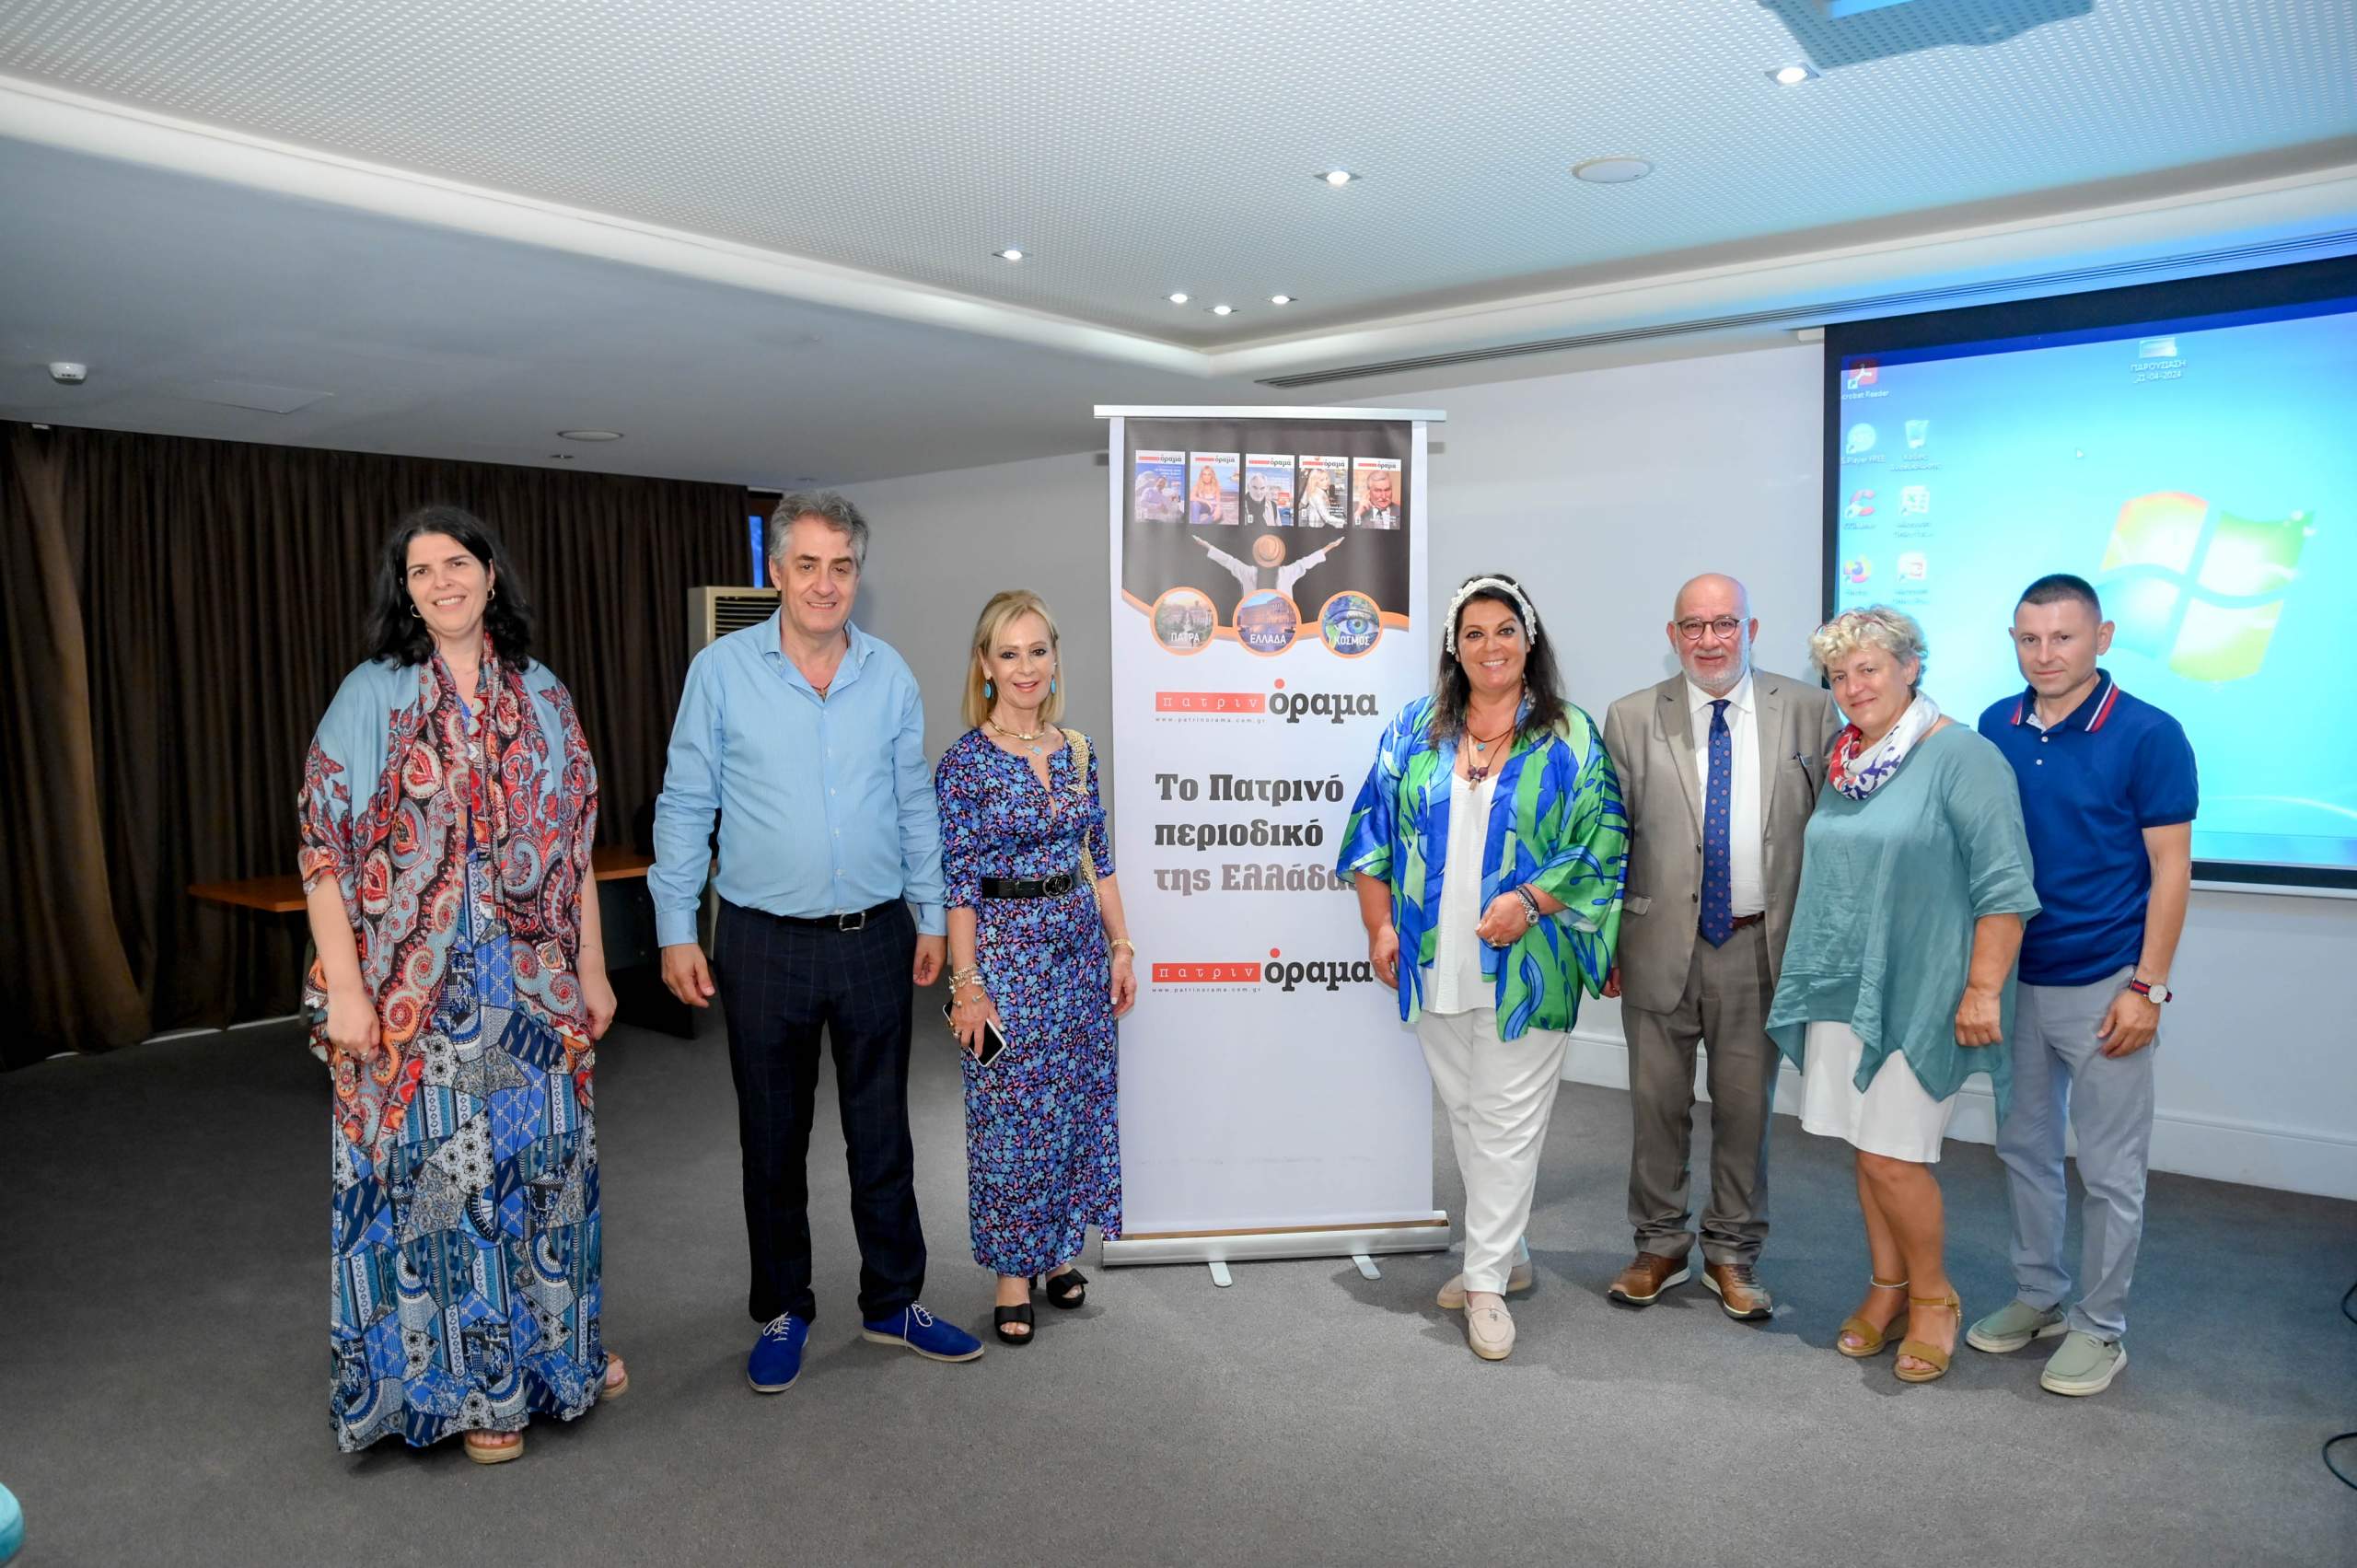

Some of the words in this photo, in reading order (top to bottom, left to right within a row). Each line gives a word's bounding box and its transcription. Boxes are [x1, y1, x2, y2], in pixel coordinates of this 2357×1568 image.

[1170, 633, 1201, 643] ΠΑΤΡΑ
[1249, 633, 1287, 645] ΕΛΛΑΔΑ
[1334, 635, 1371, 645] ΚΟΣΜΟΣ
[1155, 773, 1199, 802] Το
[1209, 773, 1344, 807] Πατρινό
[1155, 819, 1324, 852] περιοδικό
[1154, 868, 1212, 896] της
[1221, 863, 1357, 891] Ελλάδα
